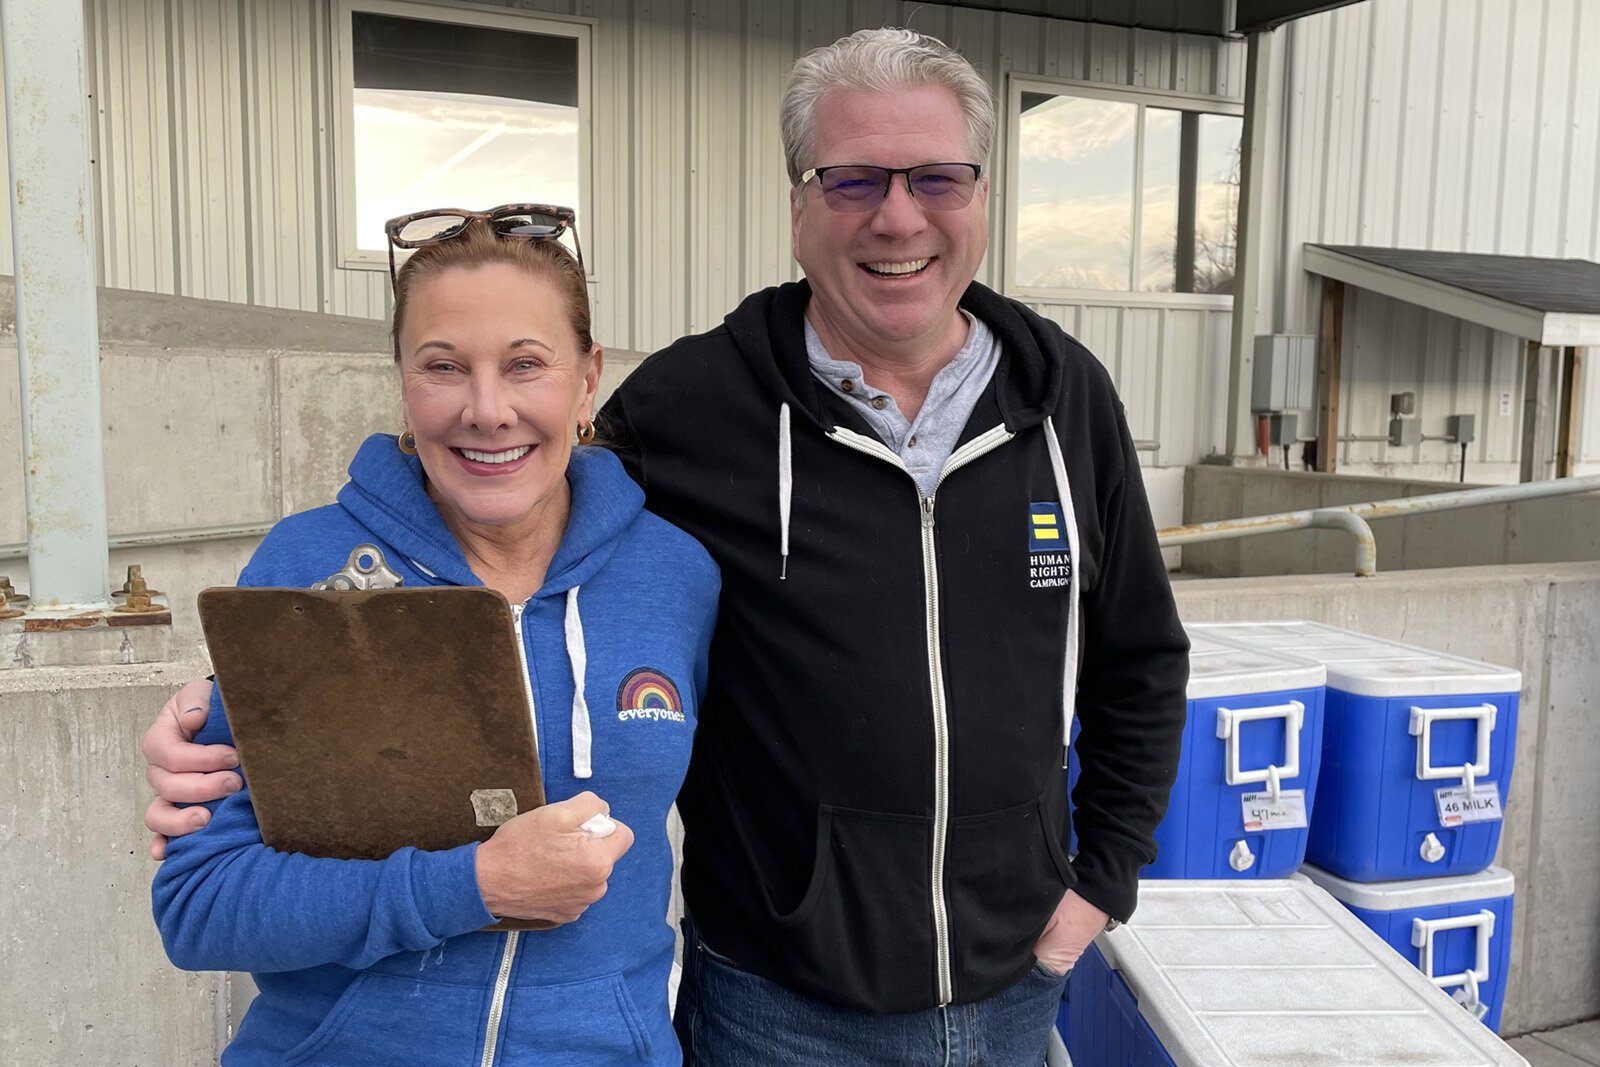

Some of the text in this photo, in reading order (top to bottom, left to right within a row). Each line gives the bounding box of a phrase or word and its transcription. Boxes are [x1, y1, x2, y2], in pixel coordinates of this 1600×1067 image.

[1030, 554, 1070, 566] HUMAN
[1030, 566, 1070, 578] RIGHTS
[1030, 577, 1070, 588] CAMPAIGN
[1445, 798, 1494, 812] 46 MILK
[1251, 808, 1269, 820] 47
